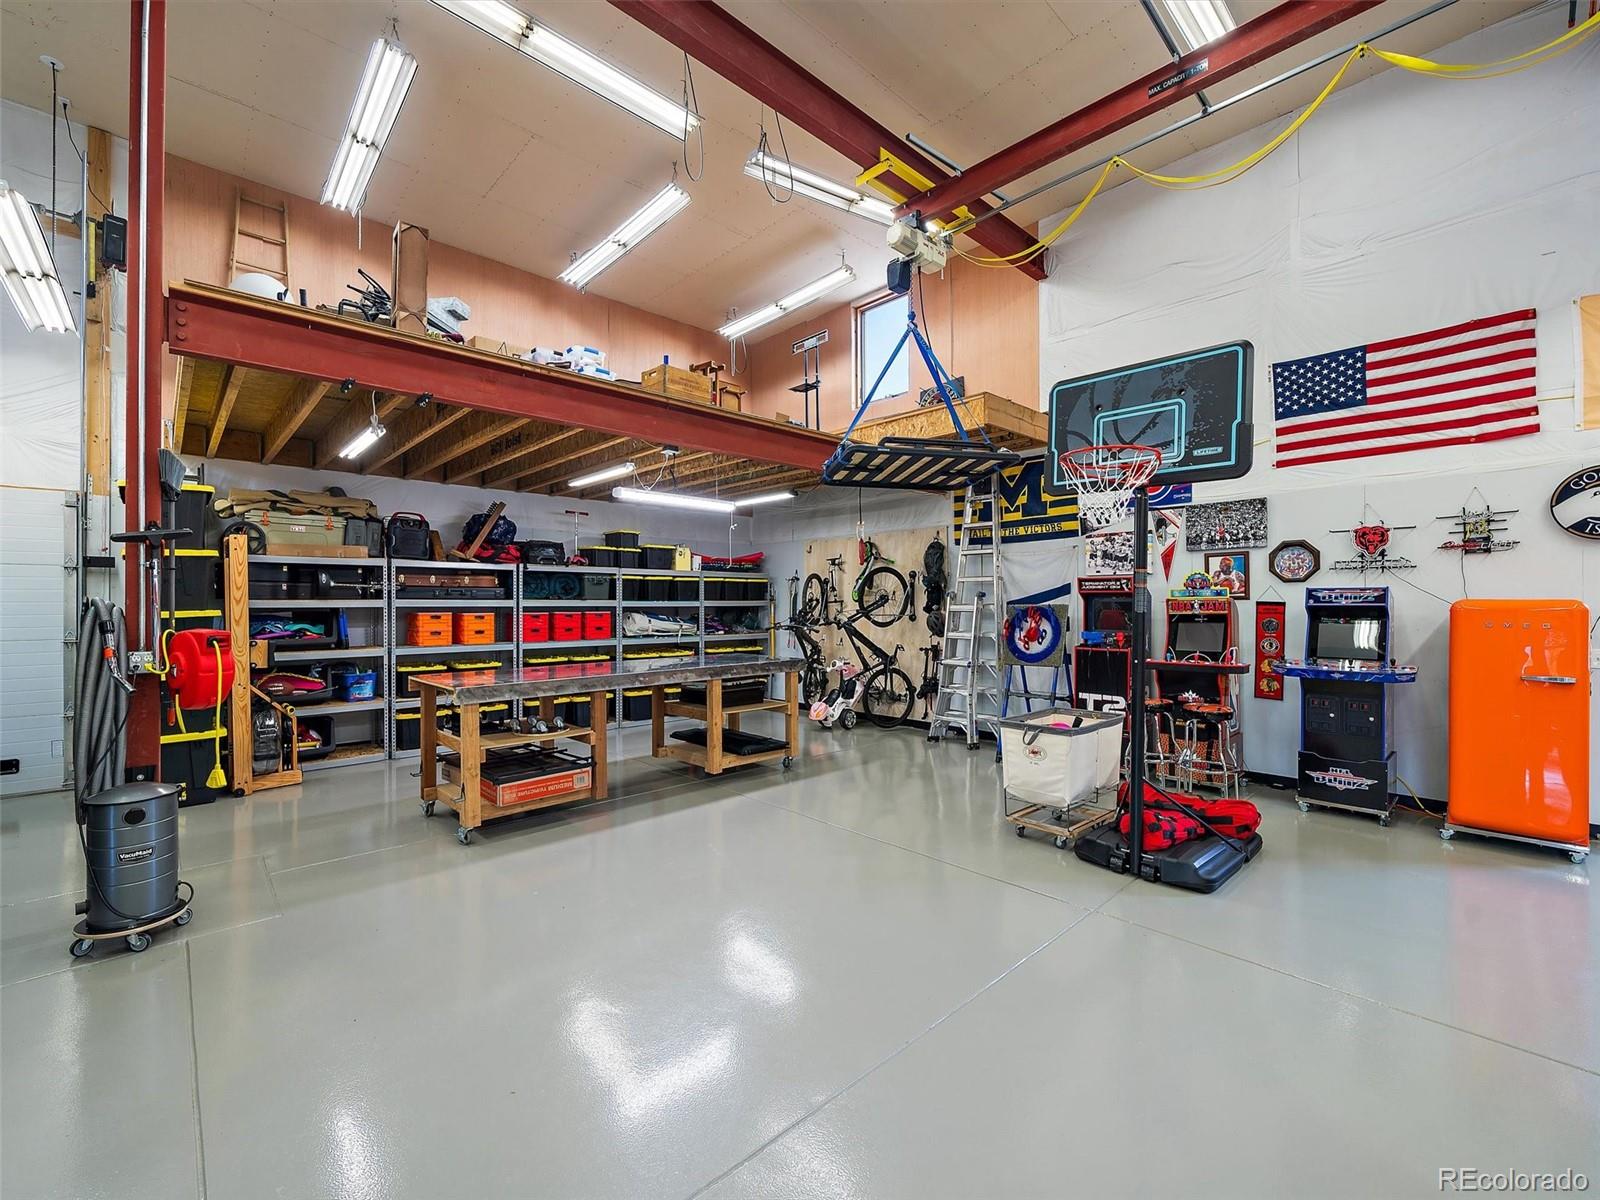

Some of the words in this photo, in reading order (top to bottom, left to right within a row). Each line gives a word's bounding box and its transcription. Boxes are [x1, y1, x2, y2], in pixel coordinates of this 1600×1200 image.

[1570, 472, 1600, 489] GO
[1001, 527, 1020, 536] THE
[1023, 523, 1063, 534] VICTORS
[1172, 600, 1192, 611] NBA
[1201, 600, 1225, 611] JAM
[1078, 692, 1126, 714] T2
[119, 848, 153, 859] VacuMaid
